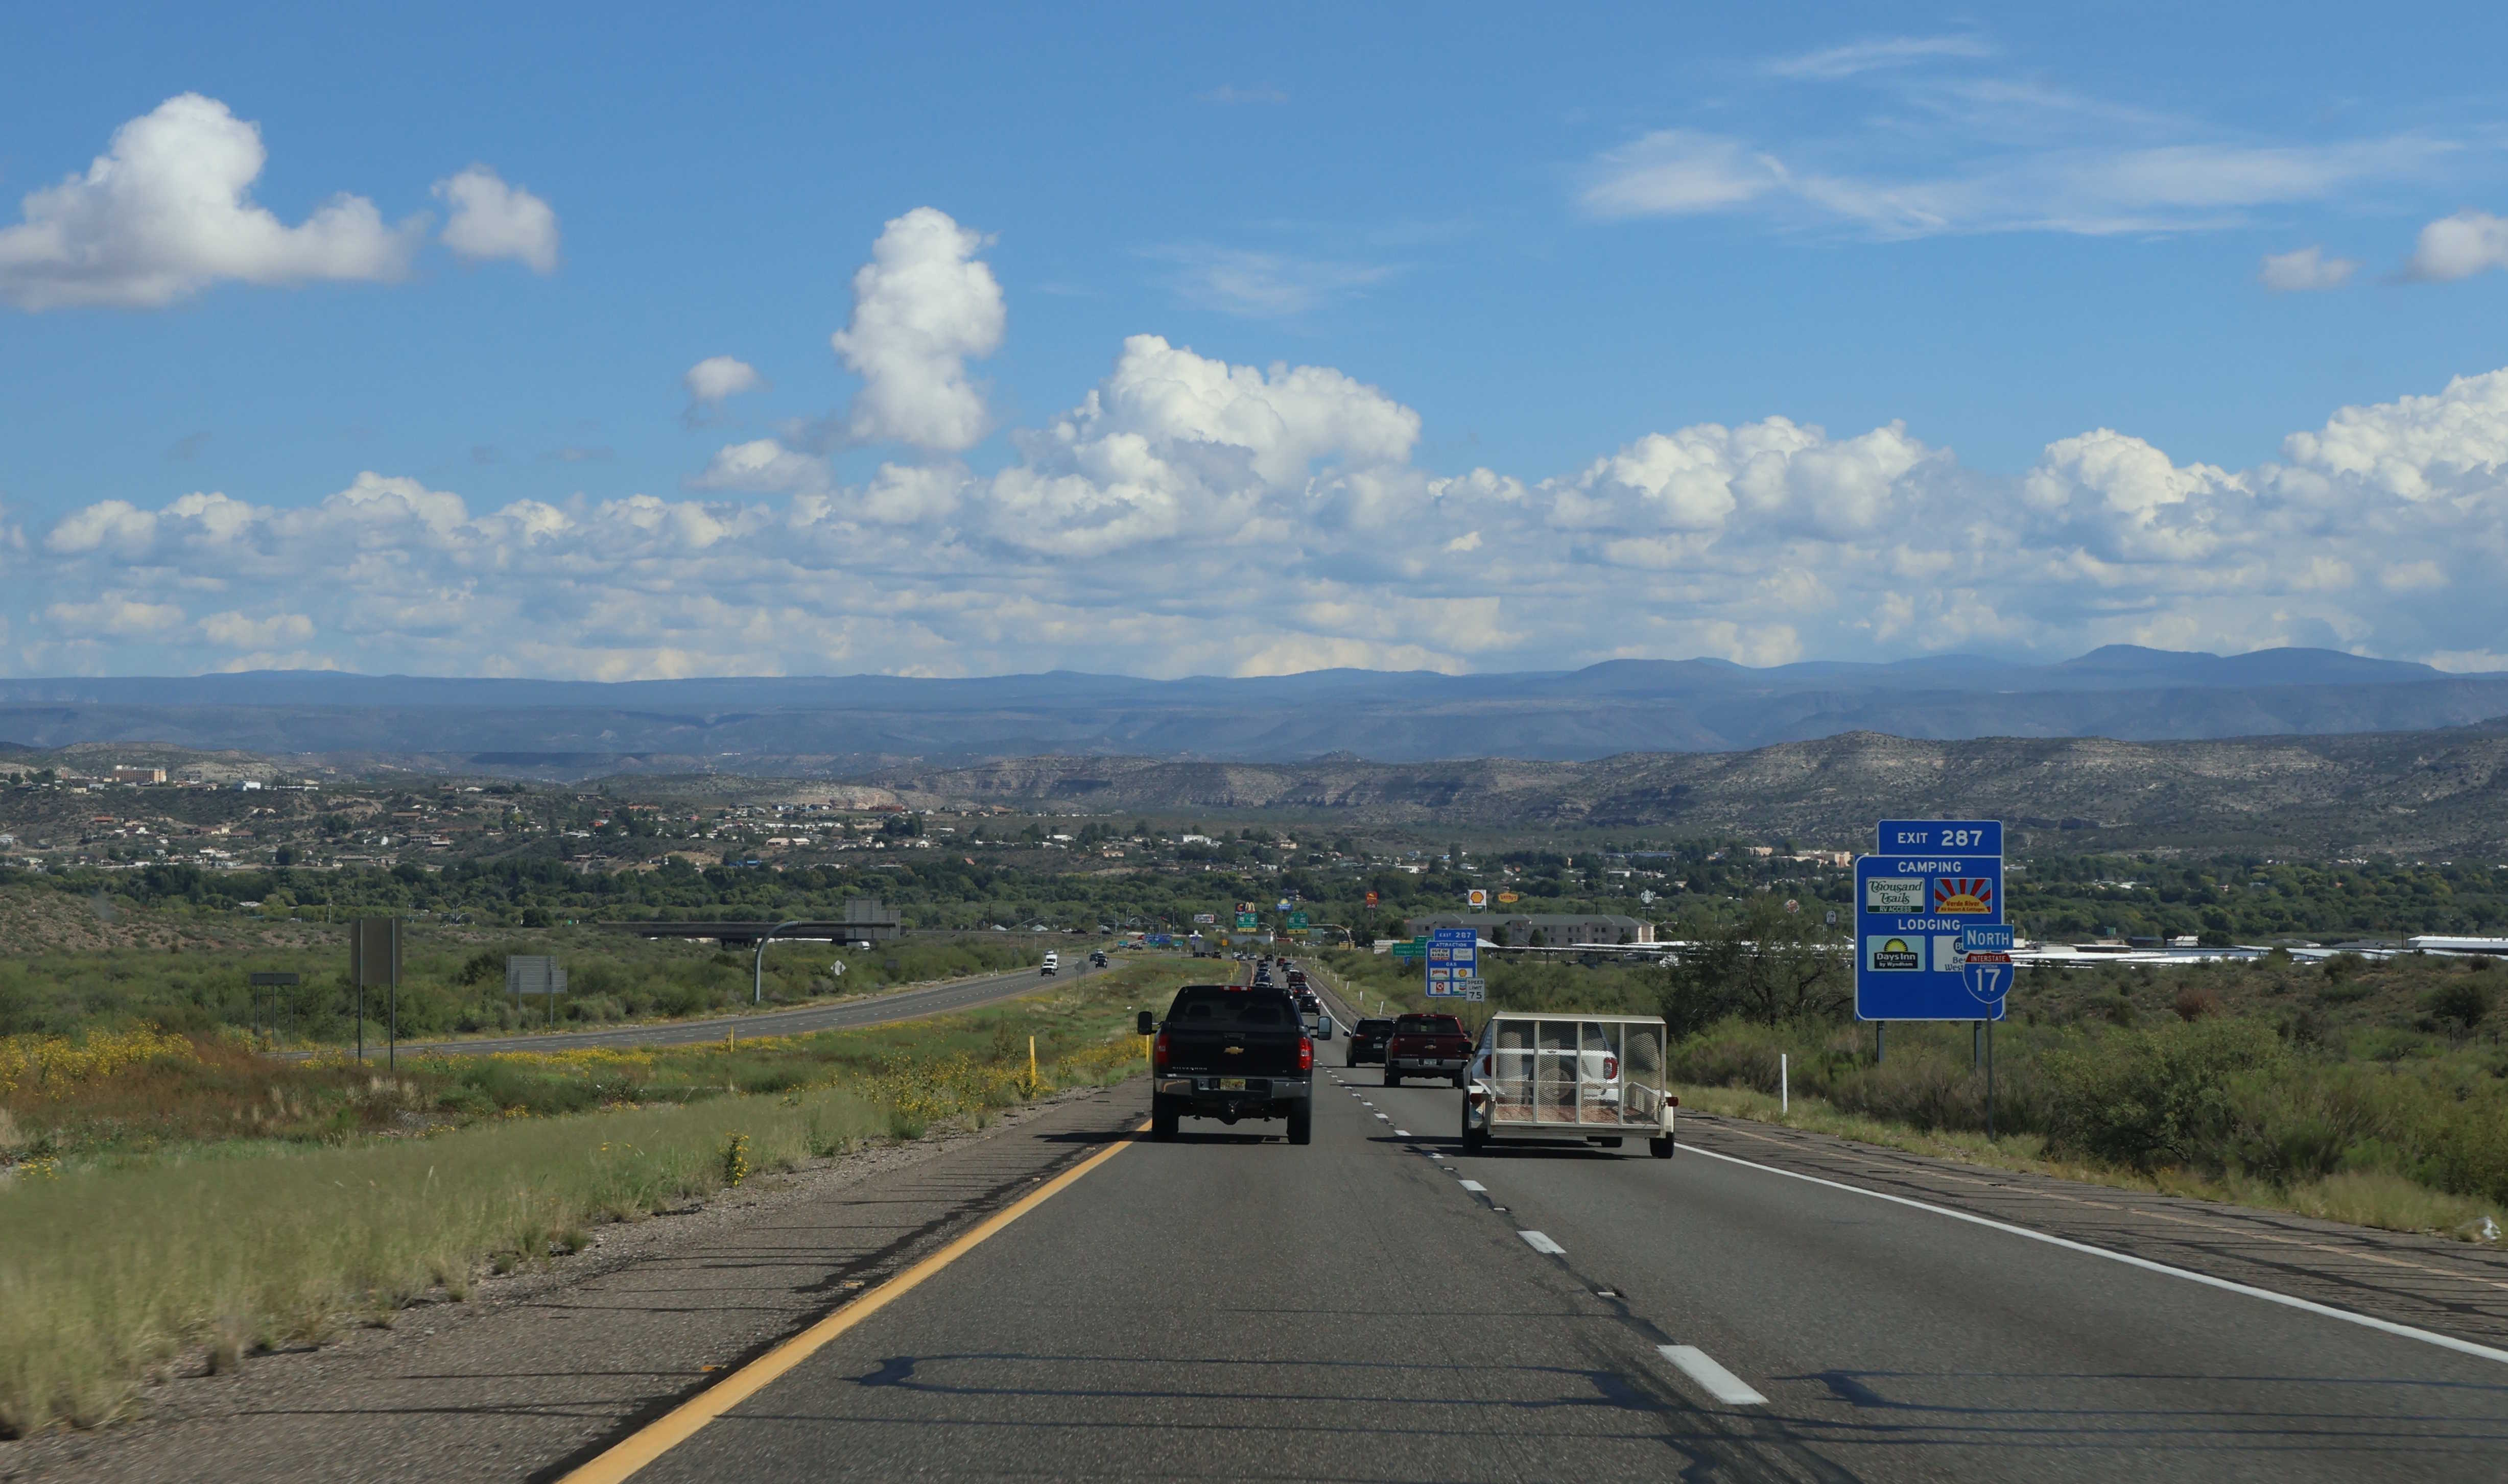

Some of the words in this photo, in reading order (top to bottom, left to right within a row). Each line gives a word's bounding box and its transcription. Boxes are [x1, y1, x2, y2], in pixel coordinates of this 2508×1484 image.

[1898, 832, 1928, 844] EXIT
[1941, 830, 1982, 846] 287
[1898, 861, 1961, 873] CAMPING
[1869, 880, 1923, 893] Thousand
[1880, 892, 1910, 904] Trails
[1898, 919, 1960, 930] LODGING
[1967, 930, 2009, 945] NORTH
[1976, 969, 2001, 991] 17
